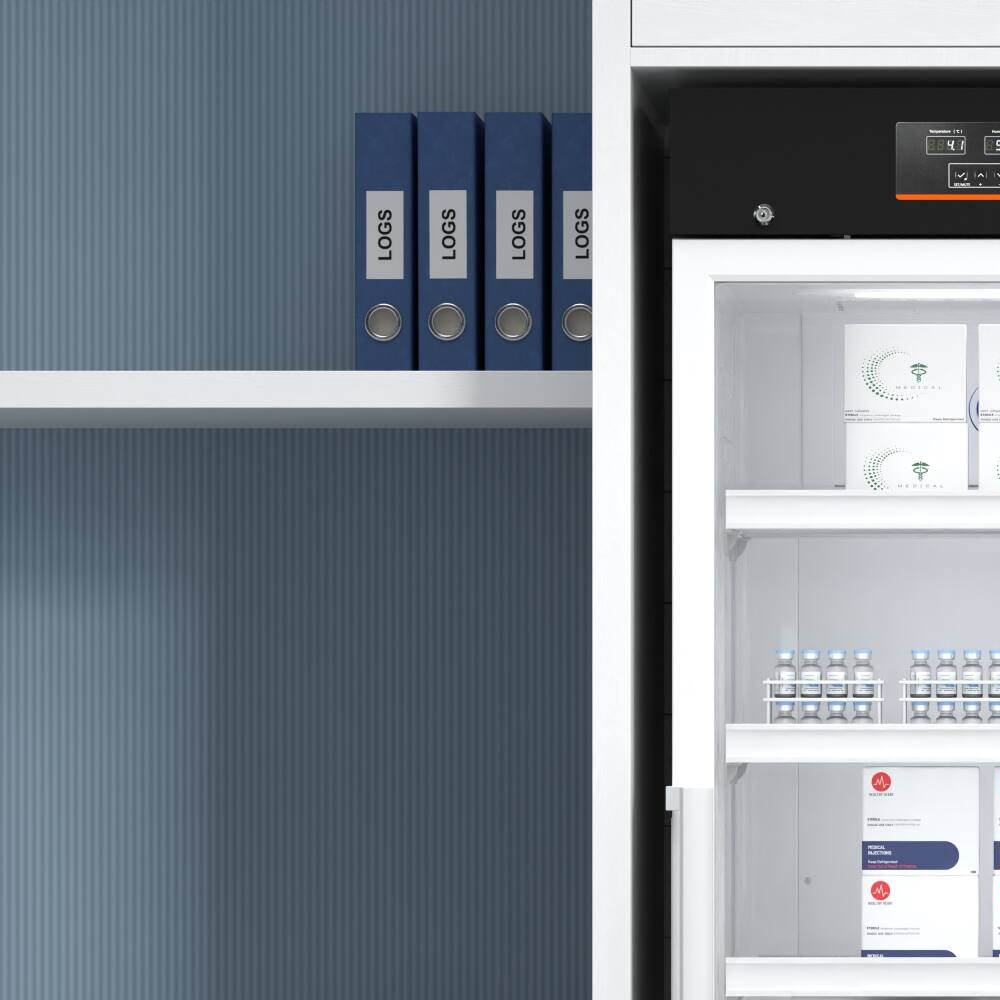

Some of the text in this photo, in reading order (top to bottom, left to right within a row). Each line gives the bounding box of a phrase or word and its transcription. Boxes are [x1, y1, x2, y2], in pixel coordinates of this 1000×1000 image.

[947, 140, 964, 151] 4.1
[378, 209, 392, 261] LOGS
[442, 208, 456, 260] LOGS
[512, 209, 526, 260] LOGS
[575, 208, 589, 259] LOGS
